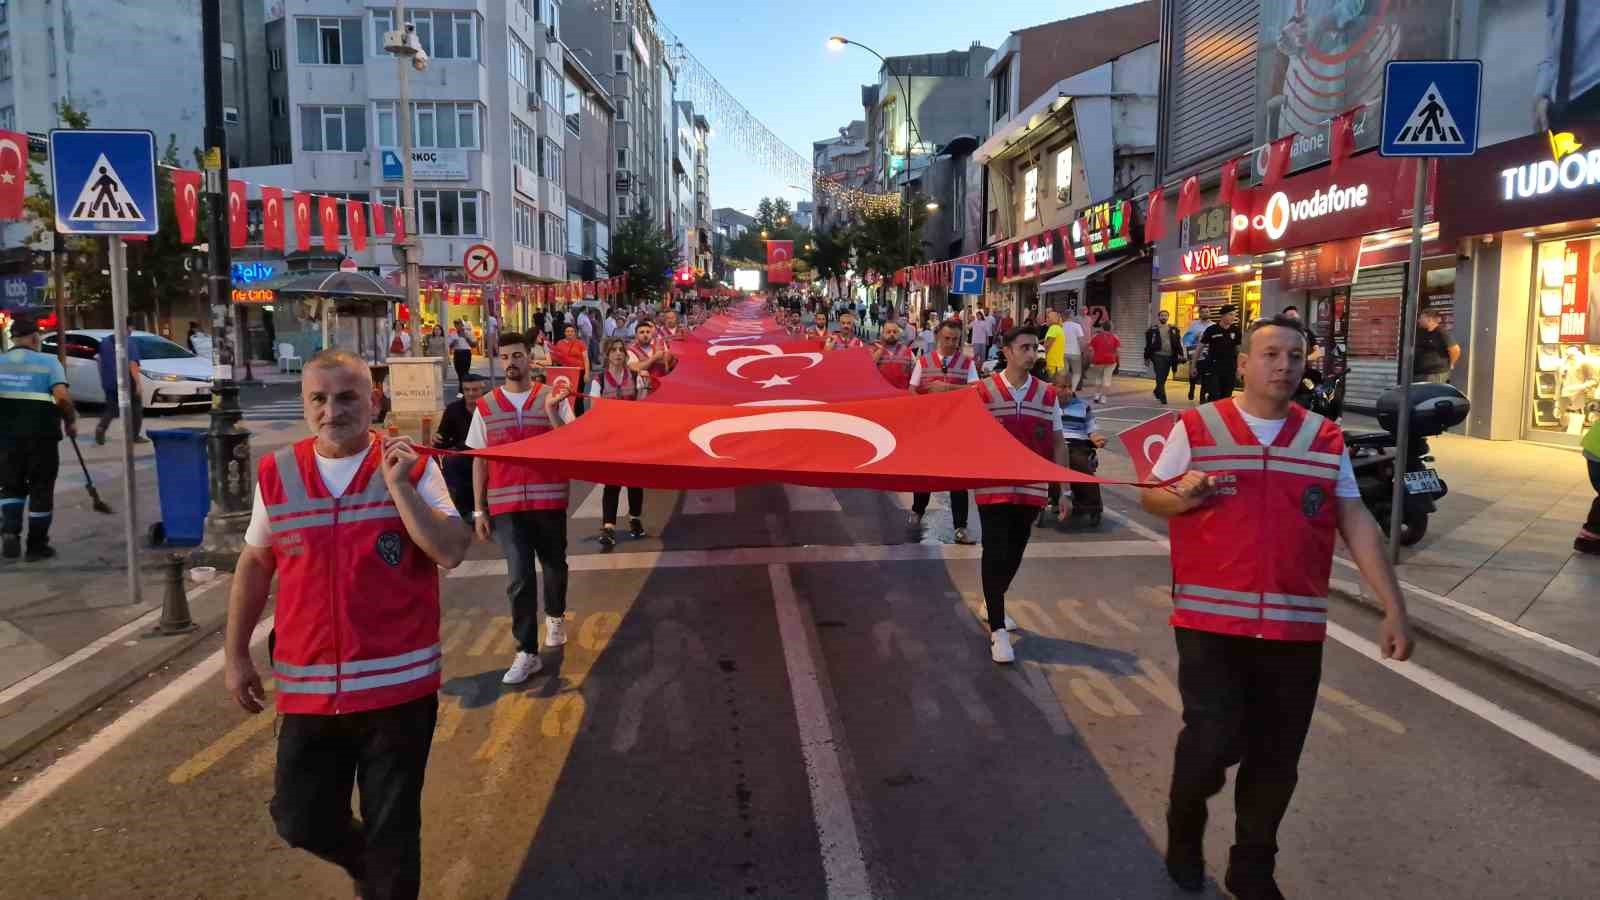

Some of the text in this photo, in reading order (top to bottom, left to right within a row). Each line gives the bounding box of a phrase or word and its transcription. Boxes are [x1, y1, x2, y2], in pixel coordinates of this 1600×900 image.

[411, 153, 437, 163] RKOÇ
[1290, 183, 1368, 222] vodafone
[960, 267, 978, 292] P
